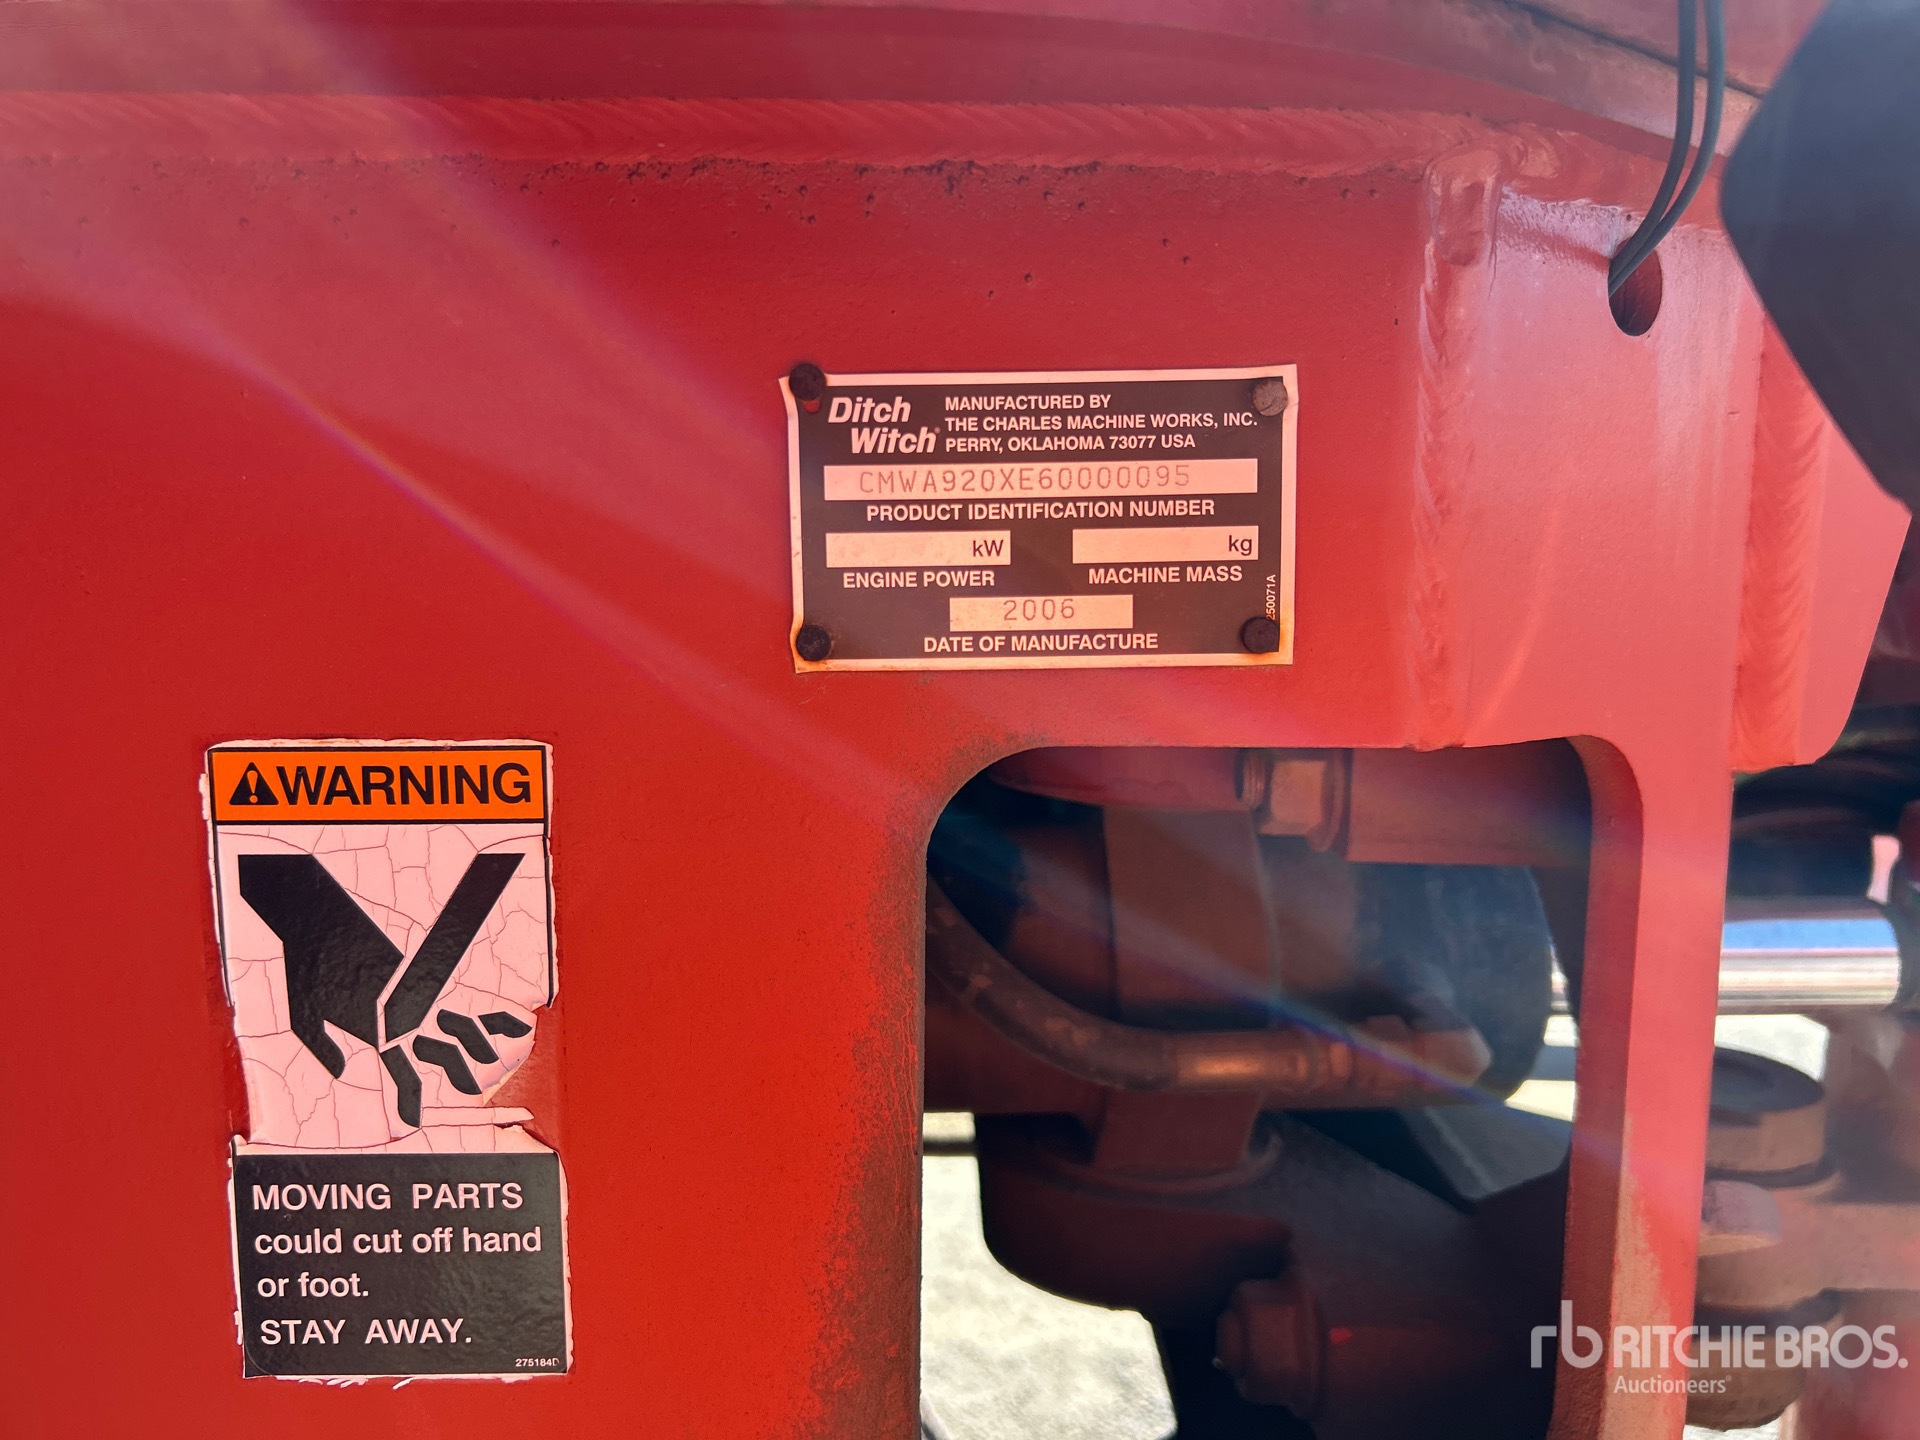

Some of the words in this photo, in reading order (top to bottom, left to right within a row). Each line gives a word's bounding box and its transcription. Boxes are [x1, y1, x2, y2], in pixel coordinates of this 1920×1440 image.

[828, 396, 911, 423] Ditch
[944, 395, 1085, 411] MANUFACTURED
[1089, 394, 1112, 409] BY
[944, 417, 979, 432] THE
[982, 415, 1063, 431] CHARLES
[1067, 414, 1146, 430] MACHINE
[1150, 412, 1219, 429] WORKS,
[1223, 412, 1258, 427] INC.
[945, 437, 1003, 454] PERRY,
[1007, 435, 1105, 451] OKLAHOMA
[1109, 434, 1157, 450] 73077
[1160, 433, 1196, 448] USA
[859, 464, 1190, 494] CMWA920XE60000095
[866, 504, 963, 522] PRODUCT
[968, 501, 1123, 520] IDENTIFICATION
[1129, 499, 1215, 516] NUMBER
[972, 539, 1004, 557] kW
[1228, 535, 1253, 556] kg
[843, 571, 918, 588] ENGINE
[923, 570, 995, 588] POWER
[1088, 567, 1181, 584] MACHINE
[1186, 565, 1243, 582] MASS
[1003, 599, 1075, 621] 2006
[923, 636, 974, 653] DATE
[979, 636, 1006, 651] OF
[1011, 633, 1158, 651] MANUFACTURE
[276, 763, 531, 806] WARNING
[252, 1184, 391, 1210] MOVING
[412, 1183, 523, 1209] PARTS
[254, 1228, 342, 1254] could
[353, 1229, 403, 1253] cut
[412, 1227, 454, 1253] off
[462, 1226, 542, 1252] hand
[257, 1279, 289, 1298] or
[298, 1272, 369, 1297] foot.
[260, 1319, 346, 1345] STAY
[364, 1318, 472, 1344] AWAY.
[515, 1357, 560, 1367] 275184D
